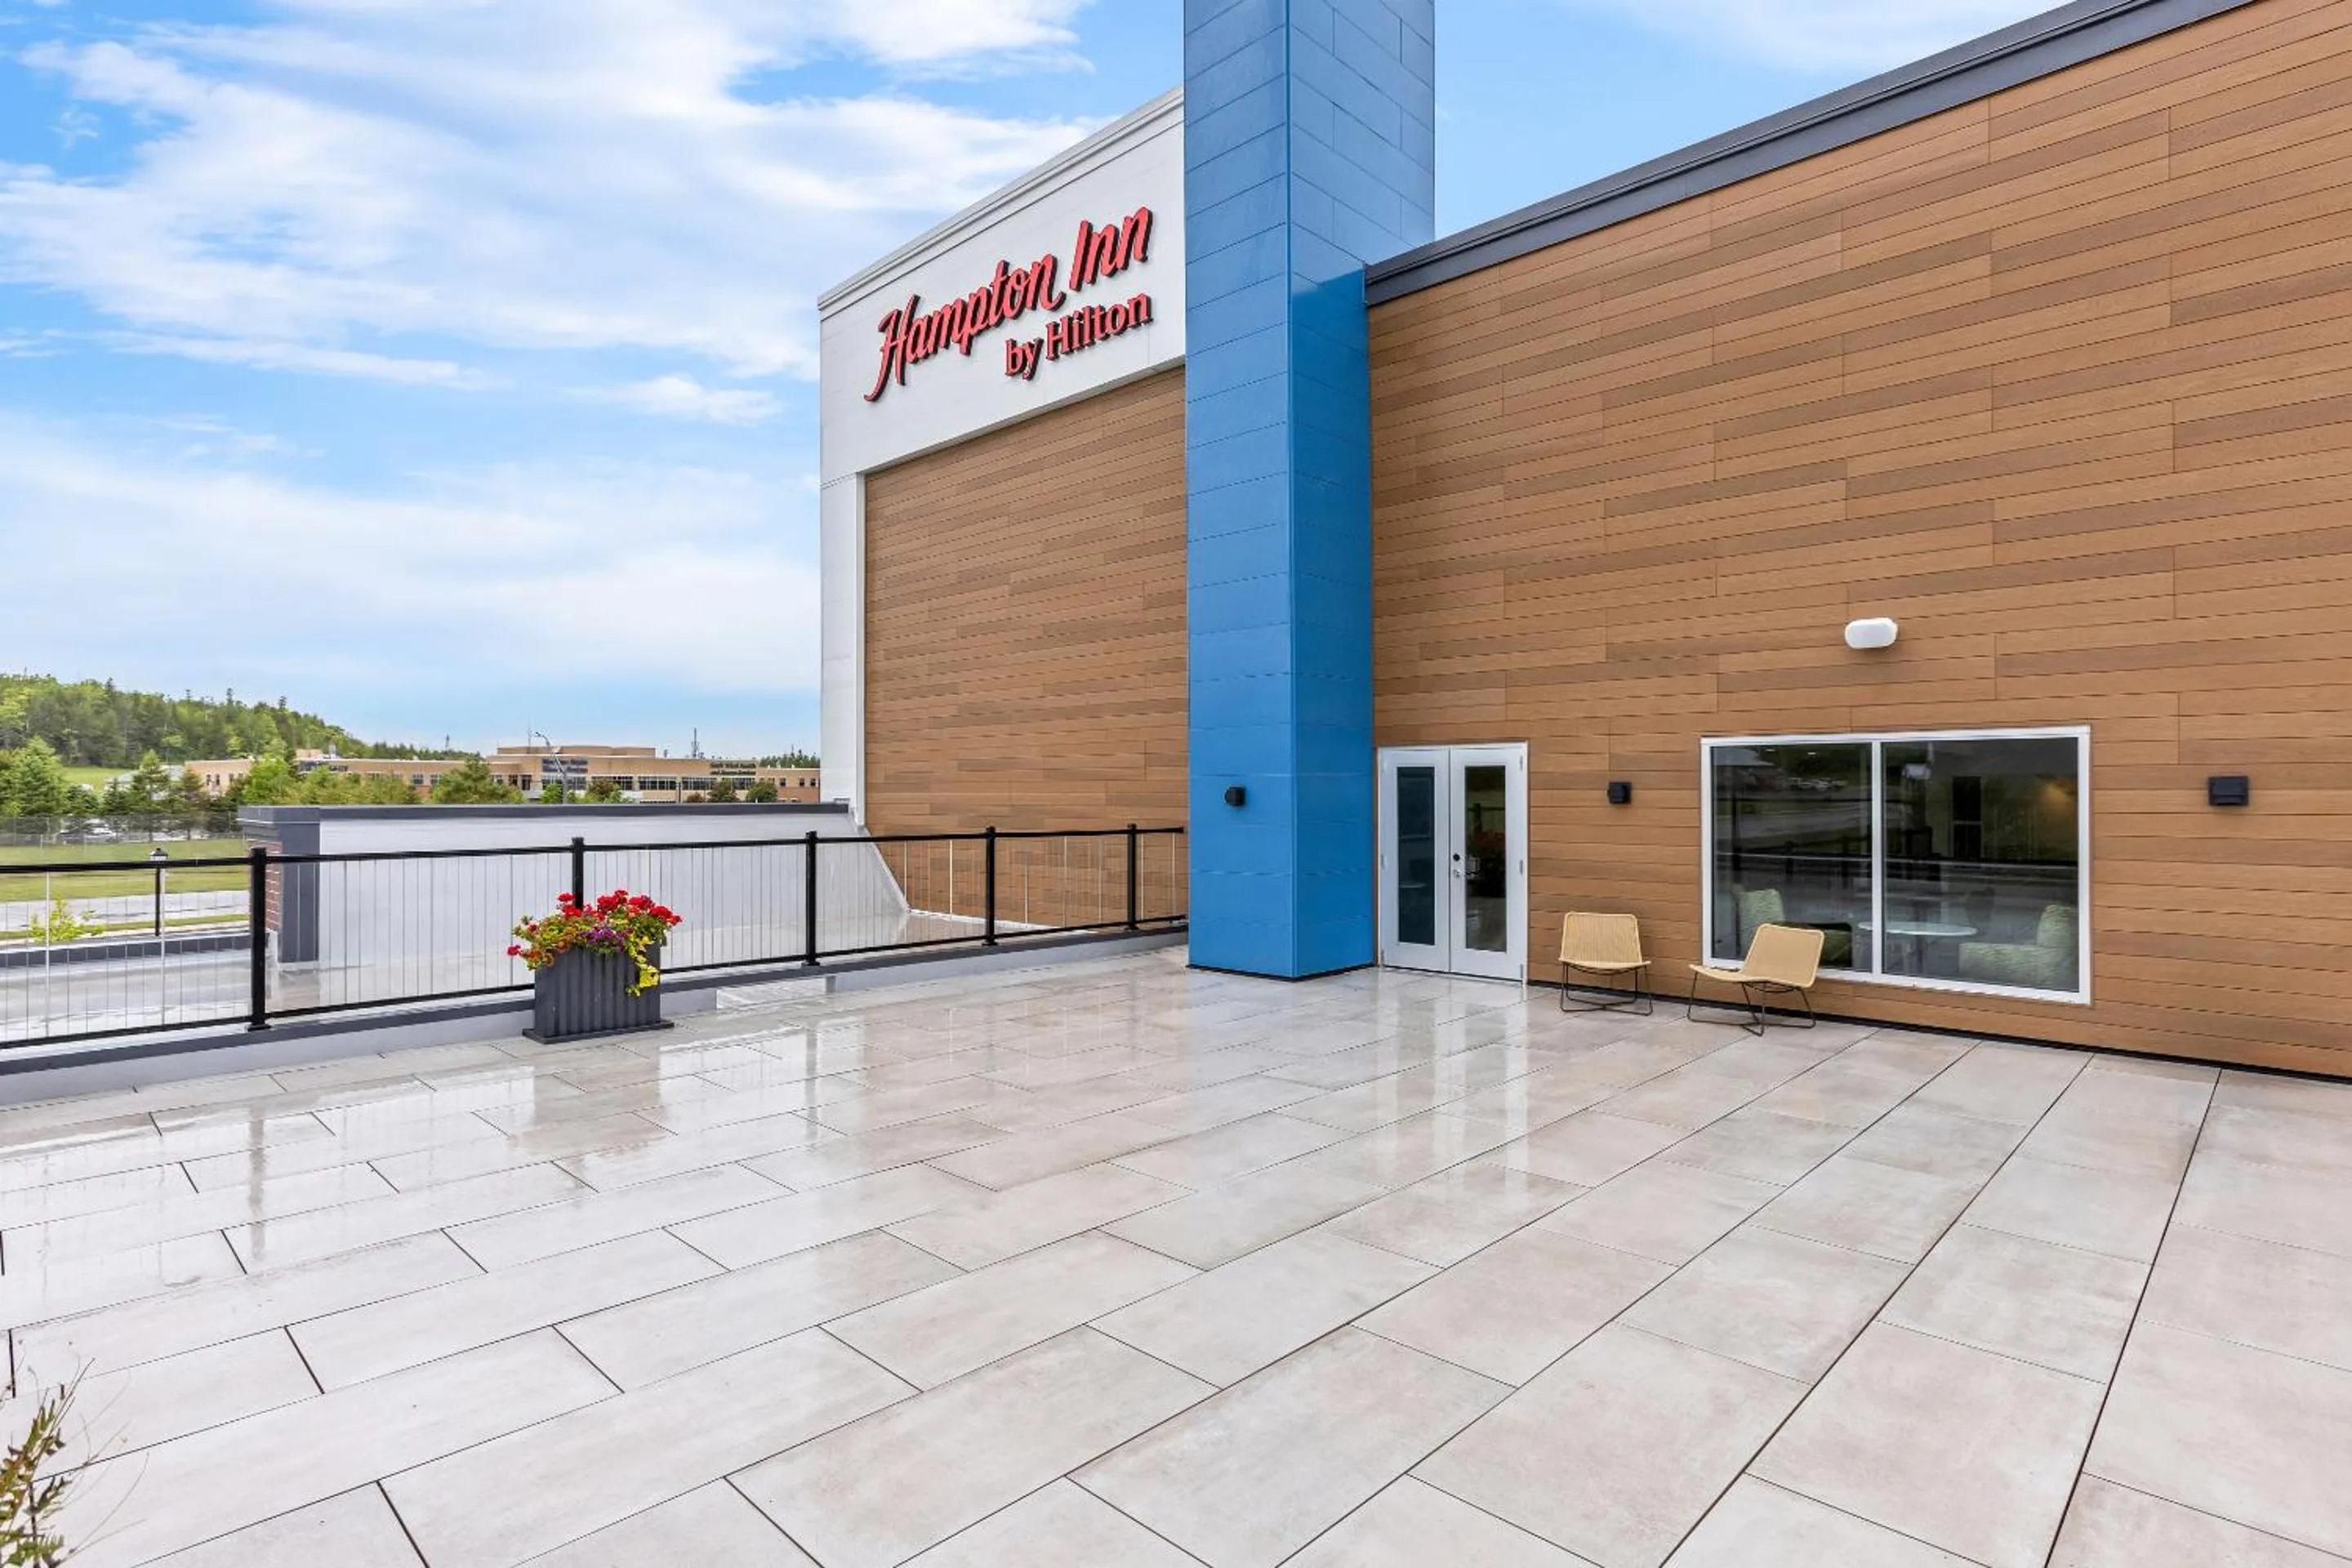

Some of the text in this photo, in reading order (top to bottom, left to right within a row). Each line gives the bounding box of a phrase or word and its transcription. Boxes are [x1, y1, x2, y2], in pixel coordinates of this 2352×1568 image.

[864, 207, 1153, 401] Hampton Inn
[1004, 292, 1153, 381] by Hilton
